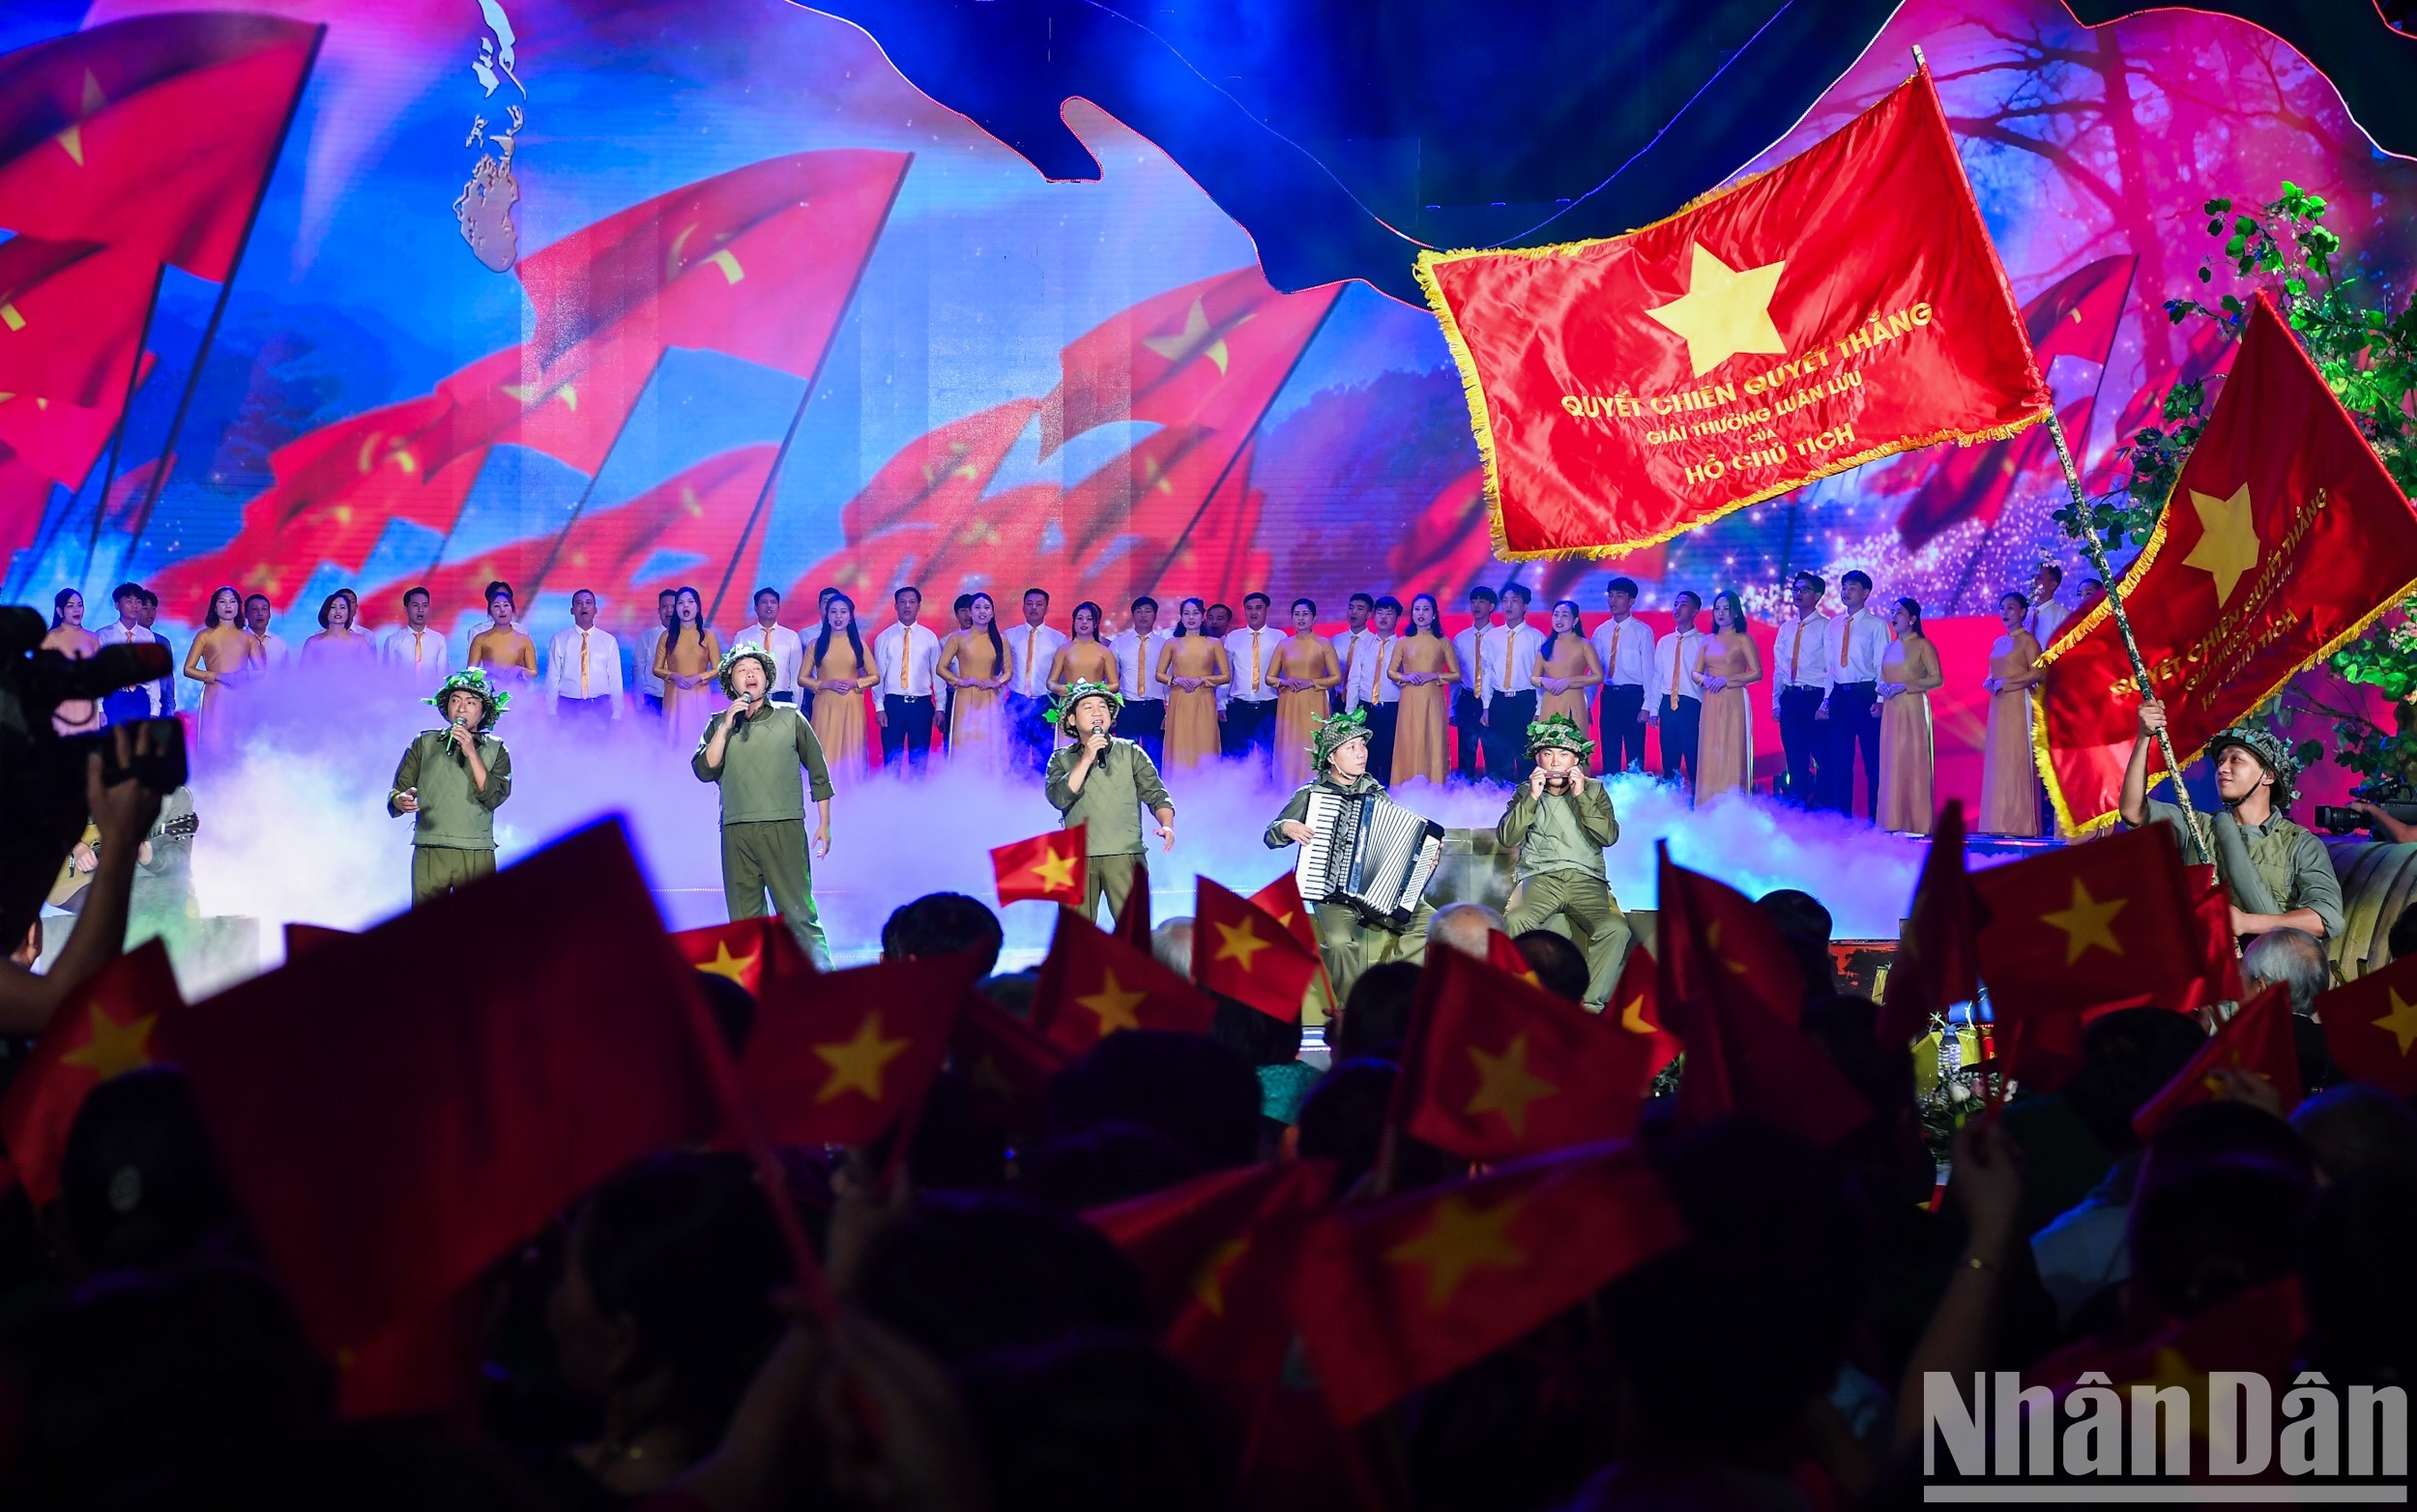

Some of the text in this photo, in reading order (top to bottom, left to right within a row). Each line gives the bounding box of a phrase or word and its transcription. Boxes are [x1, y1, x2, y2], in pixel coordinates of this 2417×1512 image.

[1561, 302, 1933, 419] QUYẾT CHIẾN QUYẾT THẮNG
[1646, 369, 1863, 445] GIẢI THƯỞNG LUÂN LƯU
[1747, 427, 1777, 444] CỦA
[1685, 453, 1725, 484] HỒ
[1733, 441, 1788, 471] CHỦ
[2282, 487, 2327, 556] THẮNG
